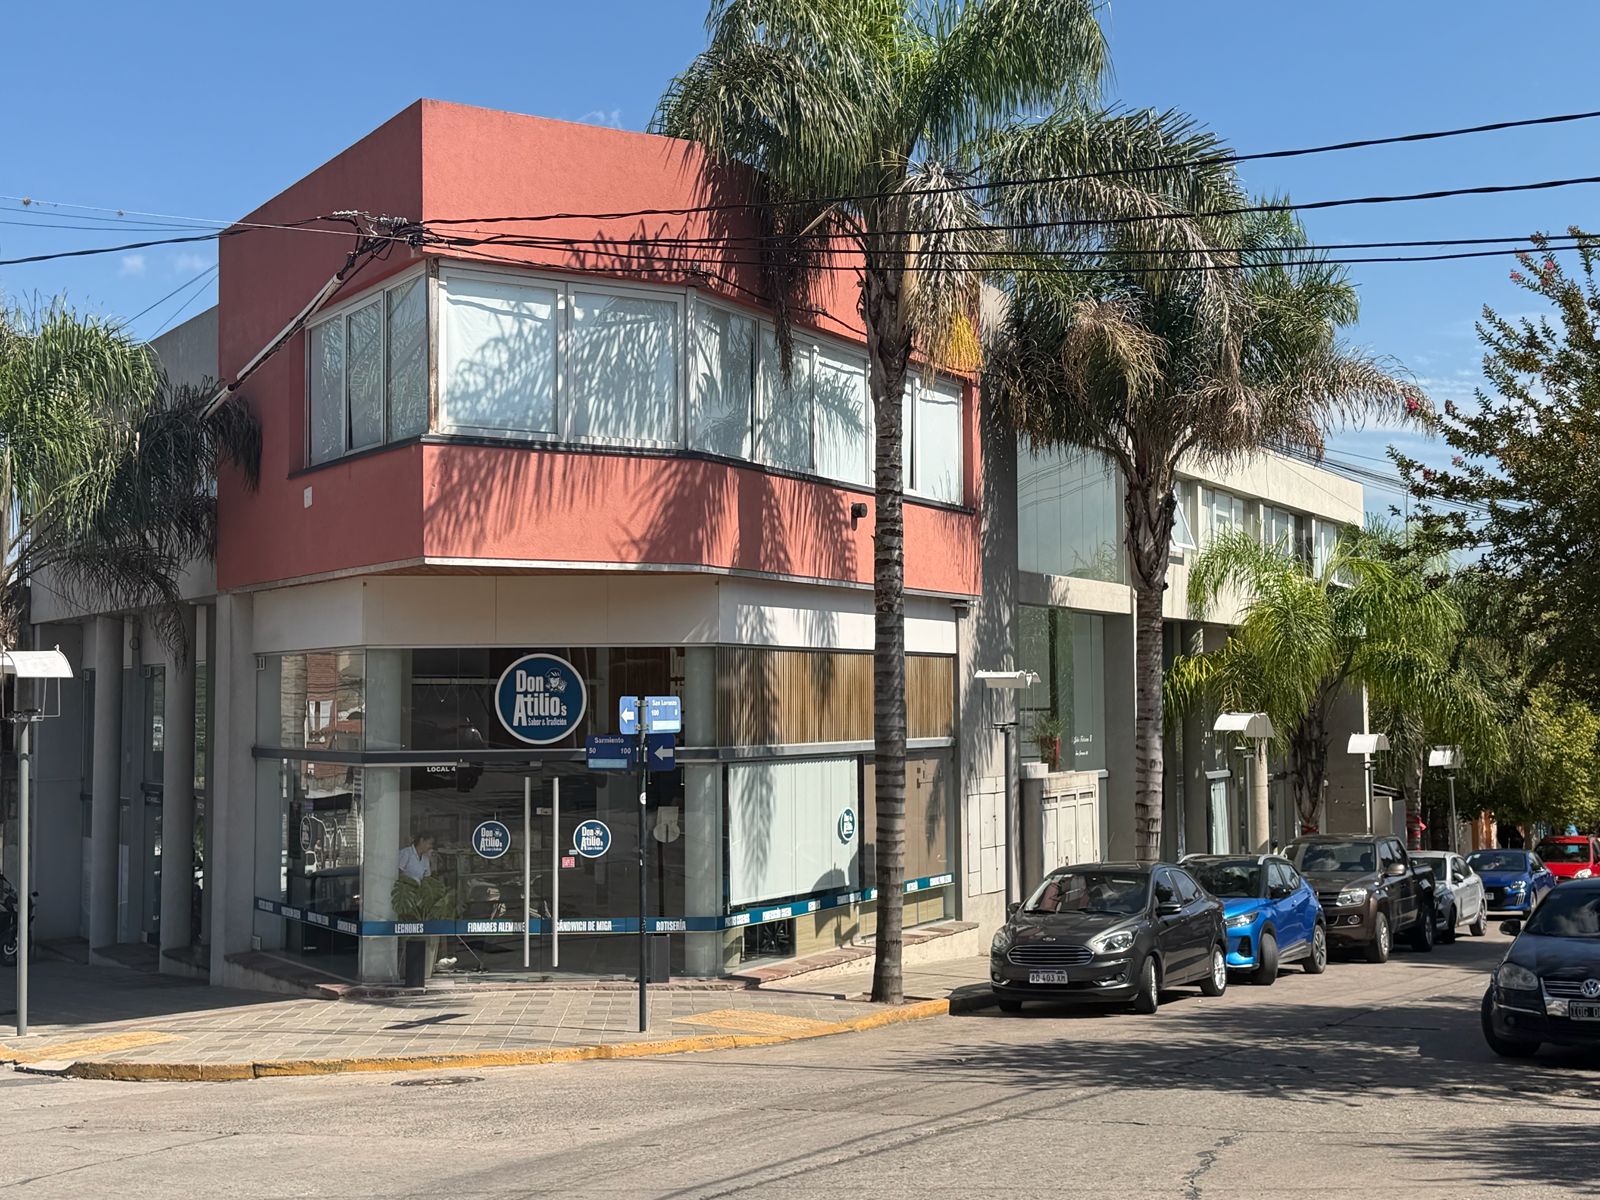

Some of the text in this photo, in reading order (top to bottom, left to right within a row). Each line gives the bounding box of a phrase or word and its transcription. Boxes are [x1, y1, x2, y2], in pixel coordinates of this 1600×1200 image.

[516, 670, 544, 692] Don
[594, 736, 625, 744] Sarmiento
[394, 922, 424, 934] LECHONES
[467, 921, 497, 933] FIAMBRES
[587, 920, 596, 931] DE
[596, 920, 612, 931] MIGA
